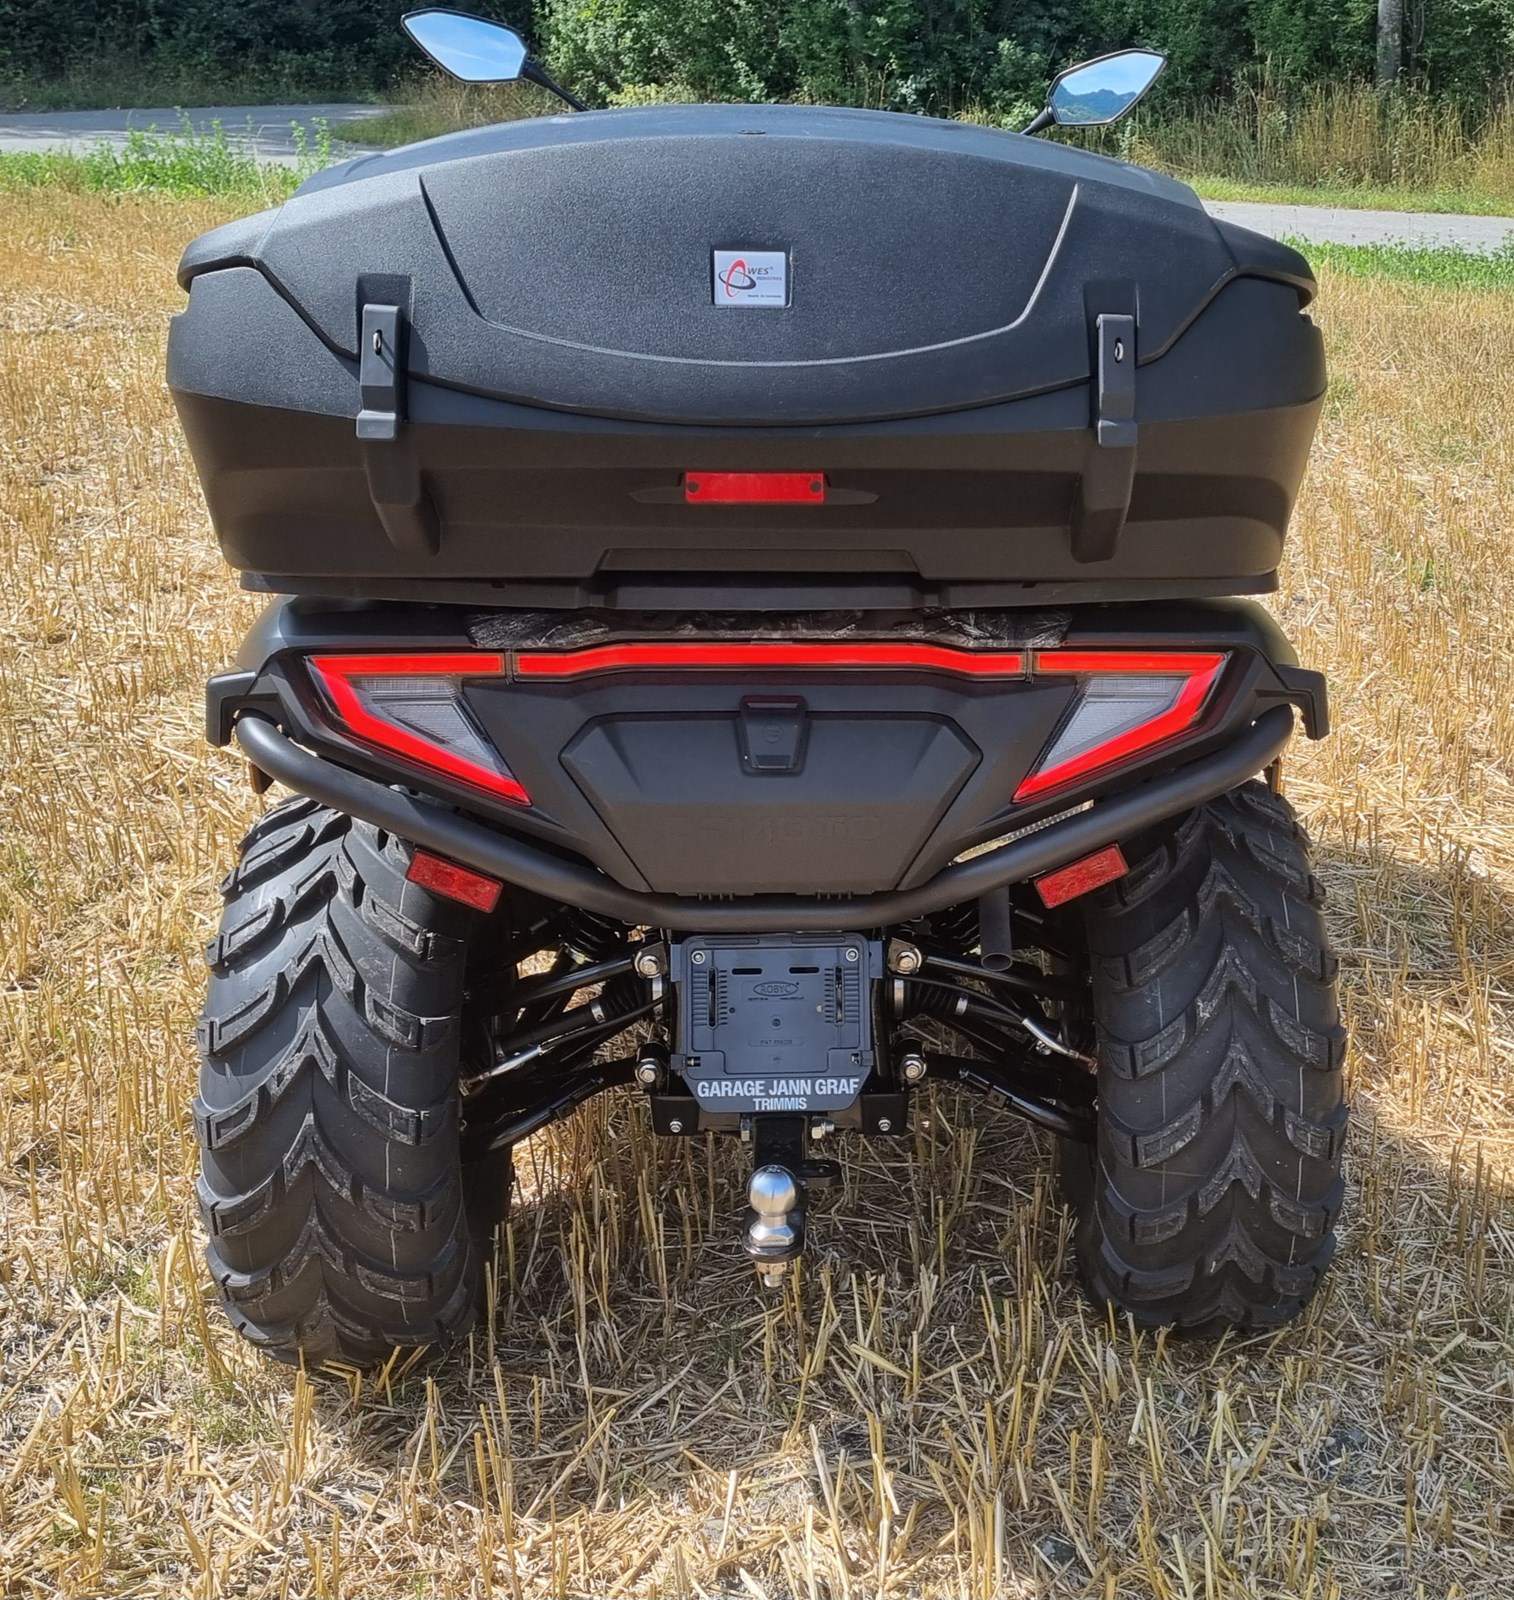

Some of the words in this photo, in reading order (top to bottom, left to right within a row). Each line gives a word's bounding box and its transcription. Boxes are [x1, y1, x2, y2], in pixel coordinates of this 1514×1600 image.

[760, 985, 791, 994] ROBYC
[697, 1080, 765, 1097] GARAGE
[769, 1079, 811, 1096] JANN
[815, 1078, 860, 1095] GRAF
[753, 1097, 807, 1111] TRIMMIS
